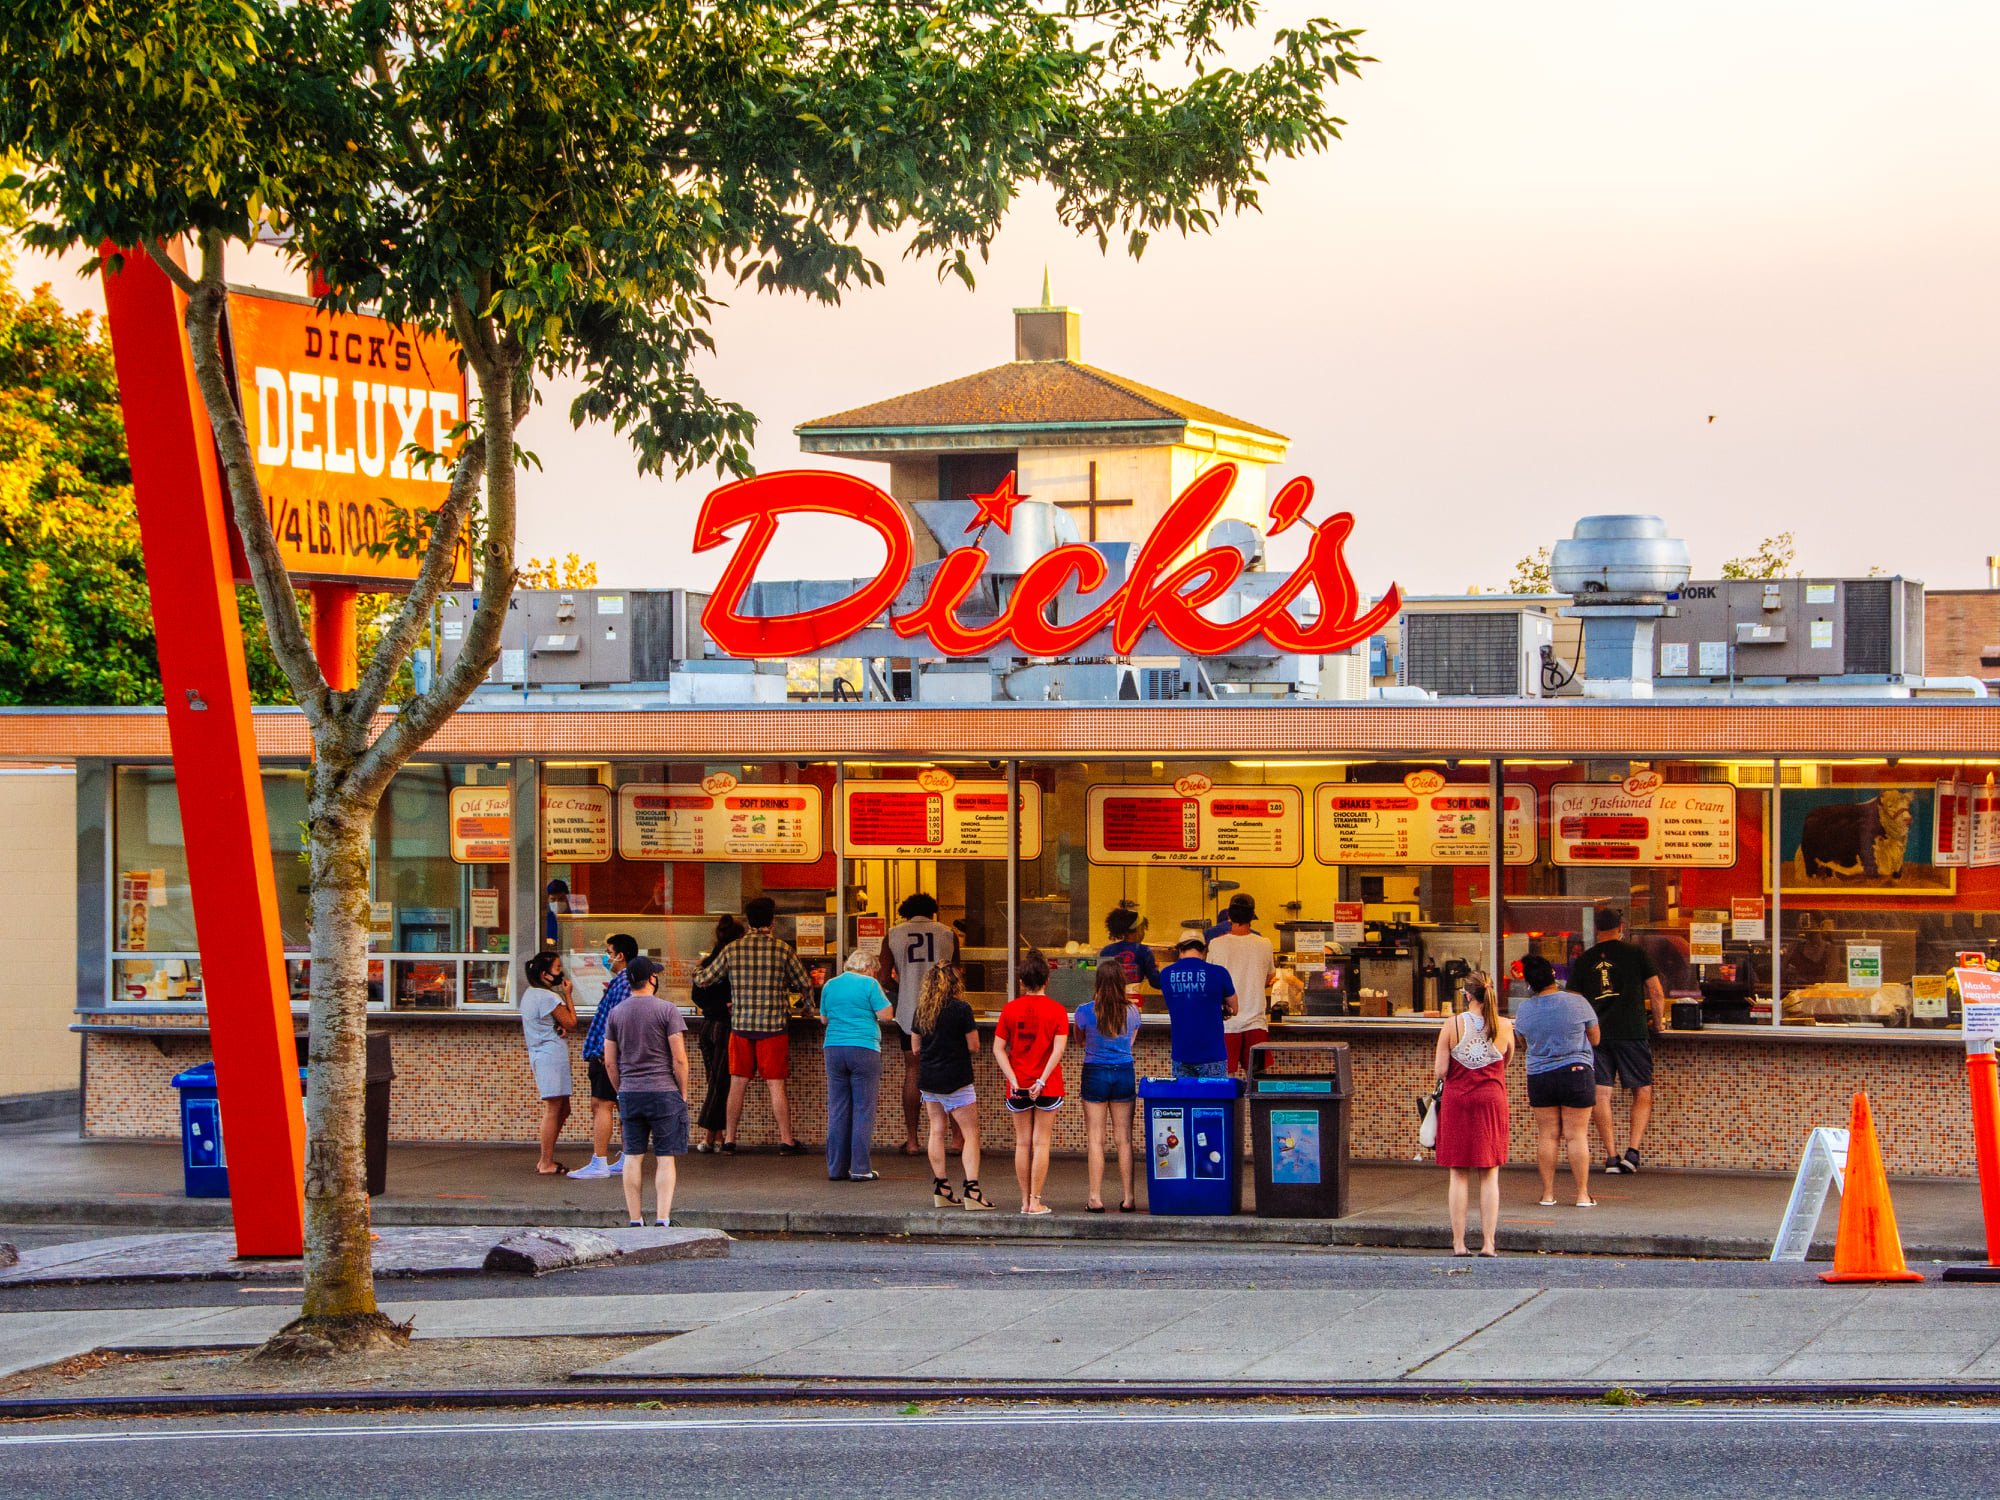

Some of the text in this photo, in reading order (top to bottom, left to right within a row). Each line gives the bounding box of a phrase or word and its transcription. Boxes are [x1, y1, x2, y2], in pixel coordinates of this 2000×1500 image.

[305, 327, 411, 371] DICK'S
[255, 366, 459, 483] DELUXE
[306, 499, 336, 555] LB.
[692, 462, 1403, 657] Dick's
[1681, 586, 1716, 599] YORK
[460, 799, 481, 813] Old
[546, 798, 603, 812] Ice Cream
[739, 799, 789, 808] SOFT DRINKS
[1339, 799, 1370, 809] SHAKES
[1447, 799, 1467, 809] SOFT
[1562, 795, 1725, 813] Old Fashioned Ice Cream
[1151, 853, 1166, 861] Open
[908, 932, 935, 964] 21
[1170, 971, 1206, 984] BEER IS
[1170, 982, 1206, 993] YUMMY
[1964, 981, 1992, 990] Masks
